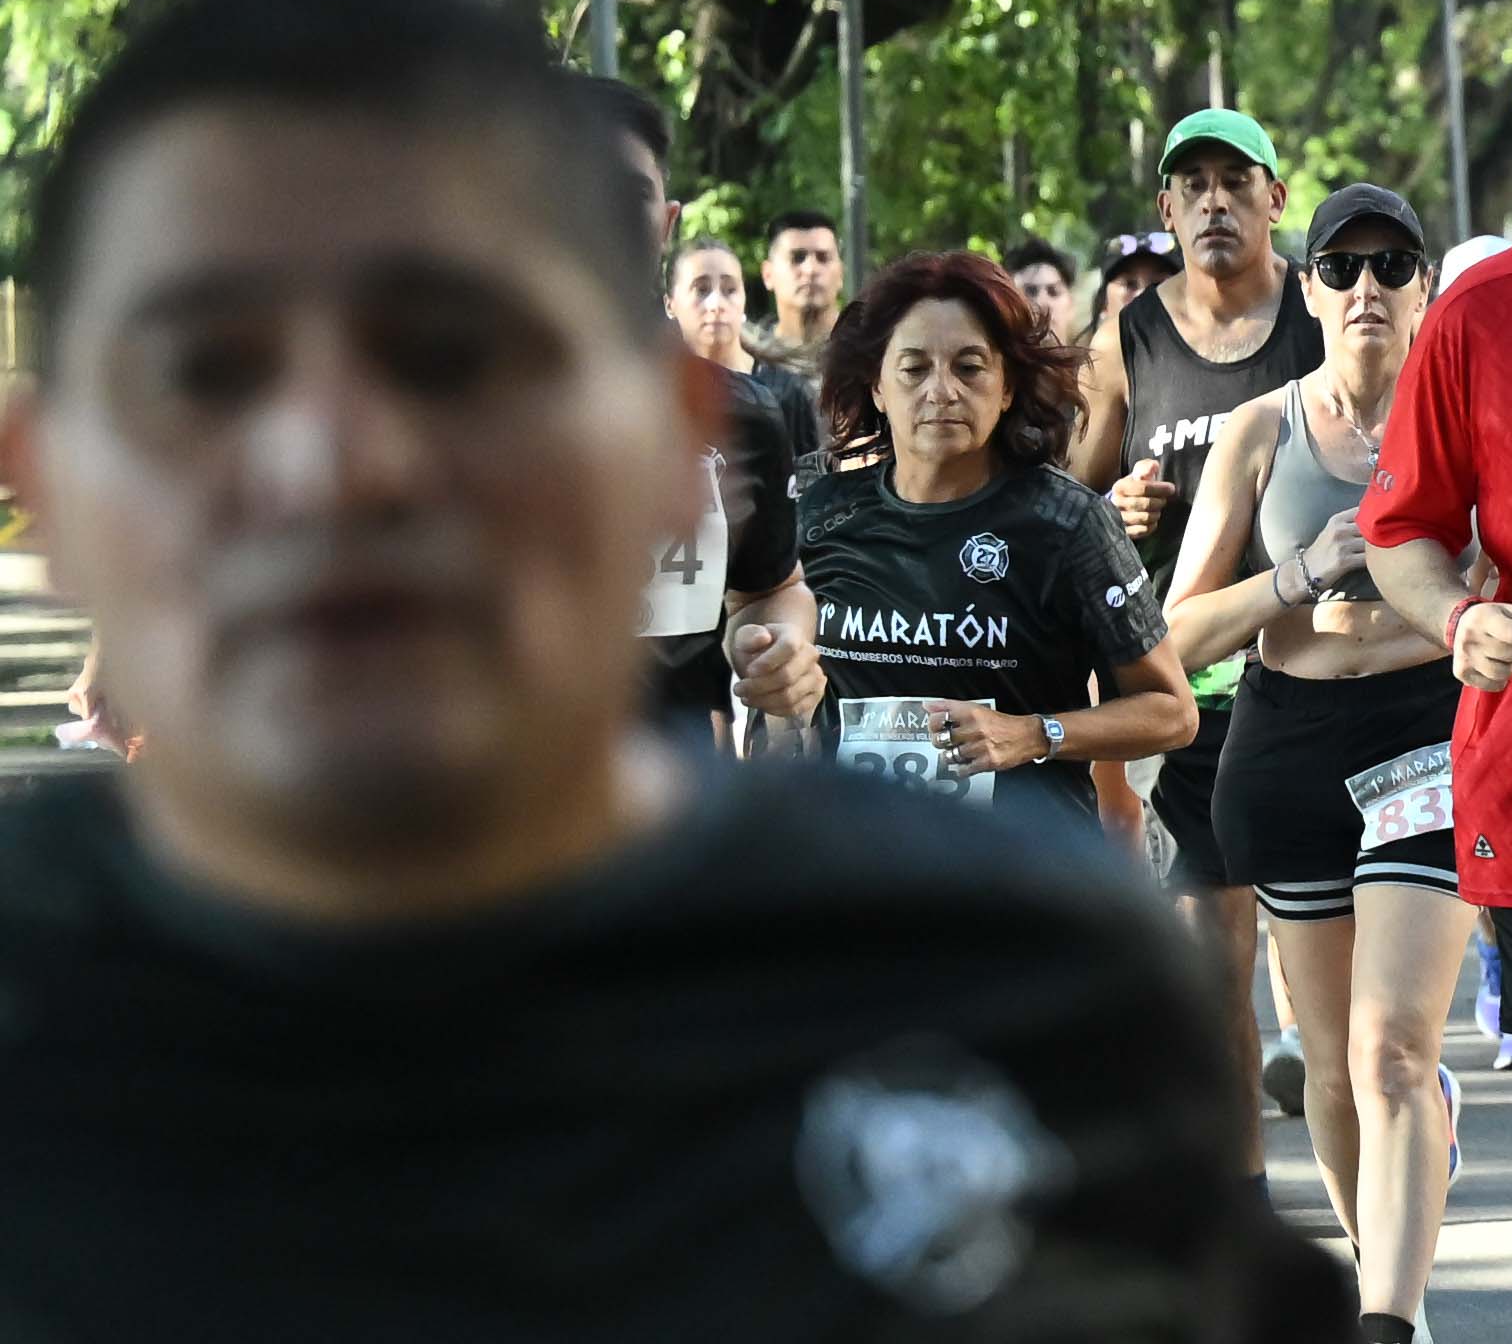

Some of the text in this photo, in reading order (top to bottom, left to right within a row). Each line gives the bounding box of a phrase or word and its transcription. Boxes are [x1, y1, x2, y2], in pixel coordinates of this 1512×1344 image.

[976, 547, 996, 566] 27
[840, 603, 1009, 649] MARATÓN
[904, 654, 974, 668] VOLUNTARIOS
[976, 658, 1018, 669] ROSARIO
